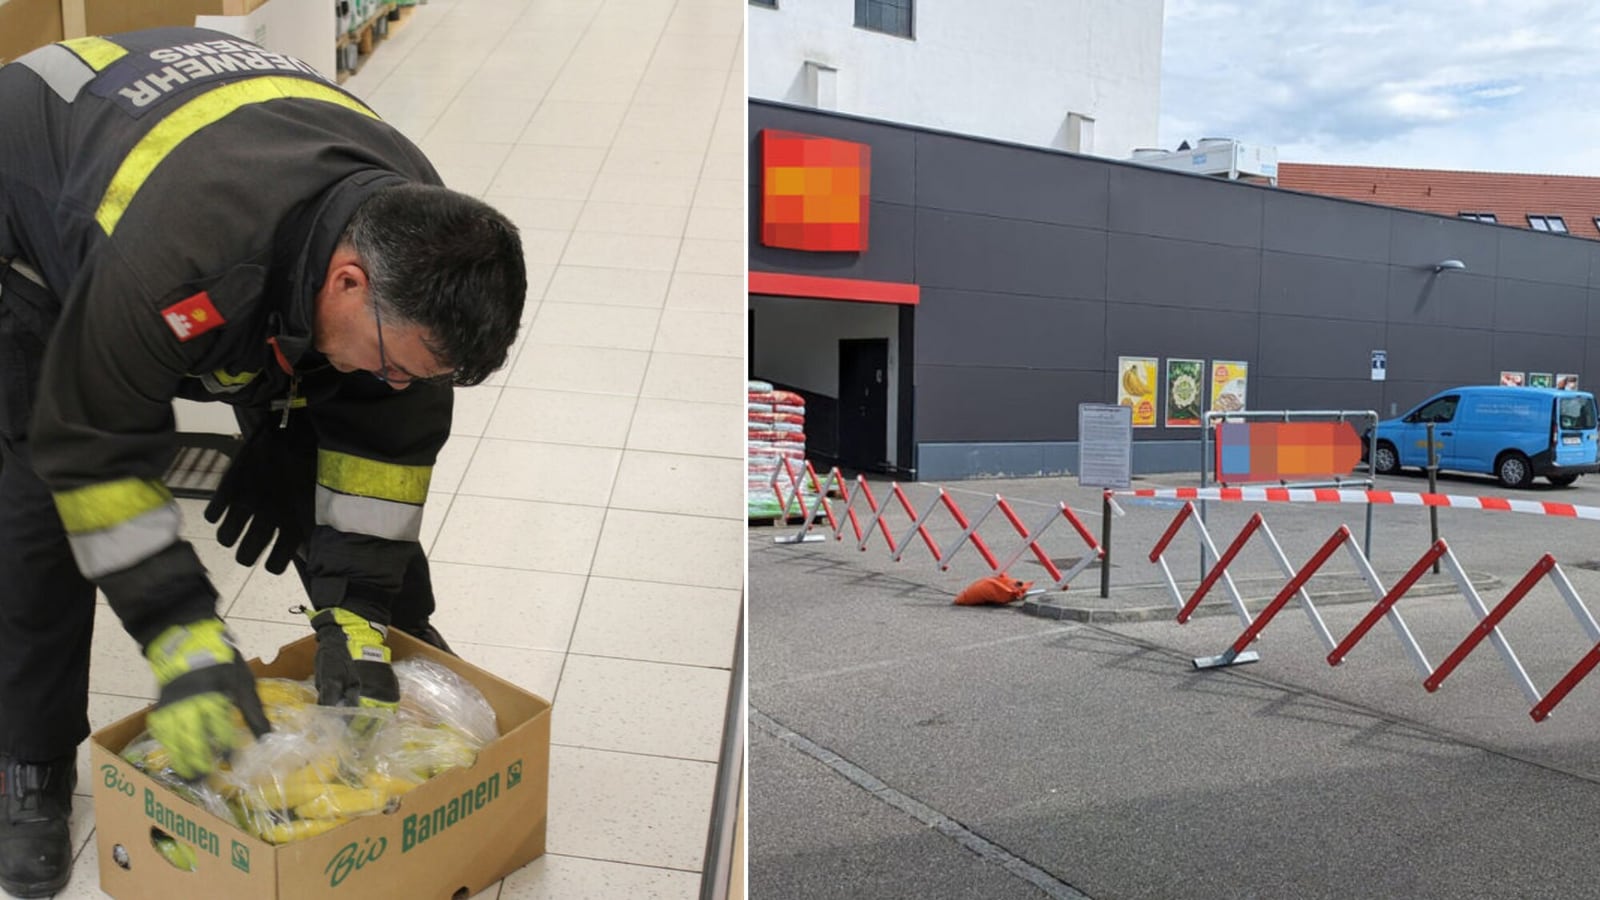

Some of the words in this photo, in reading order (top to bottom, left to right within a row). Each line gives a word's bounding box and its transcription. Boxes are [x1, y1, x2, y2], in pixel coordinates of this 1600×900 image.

[118, 53, 322, 107] UERWEHR
[150, 40, 267, 63] REMS
[100, 763, 136, 798] Bio
[143, 787, 220, 857] Bananen
[324, 835, 388, 888] Bio
[402, 771, 500, 854] Bananen
